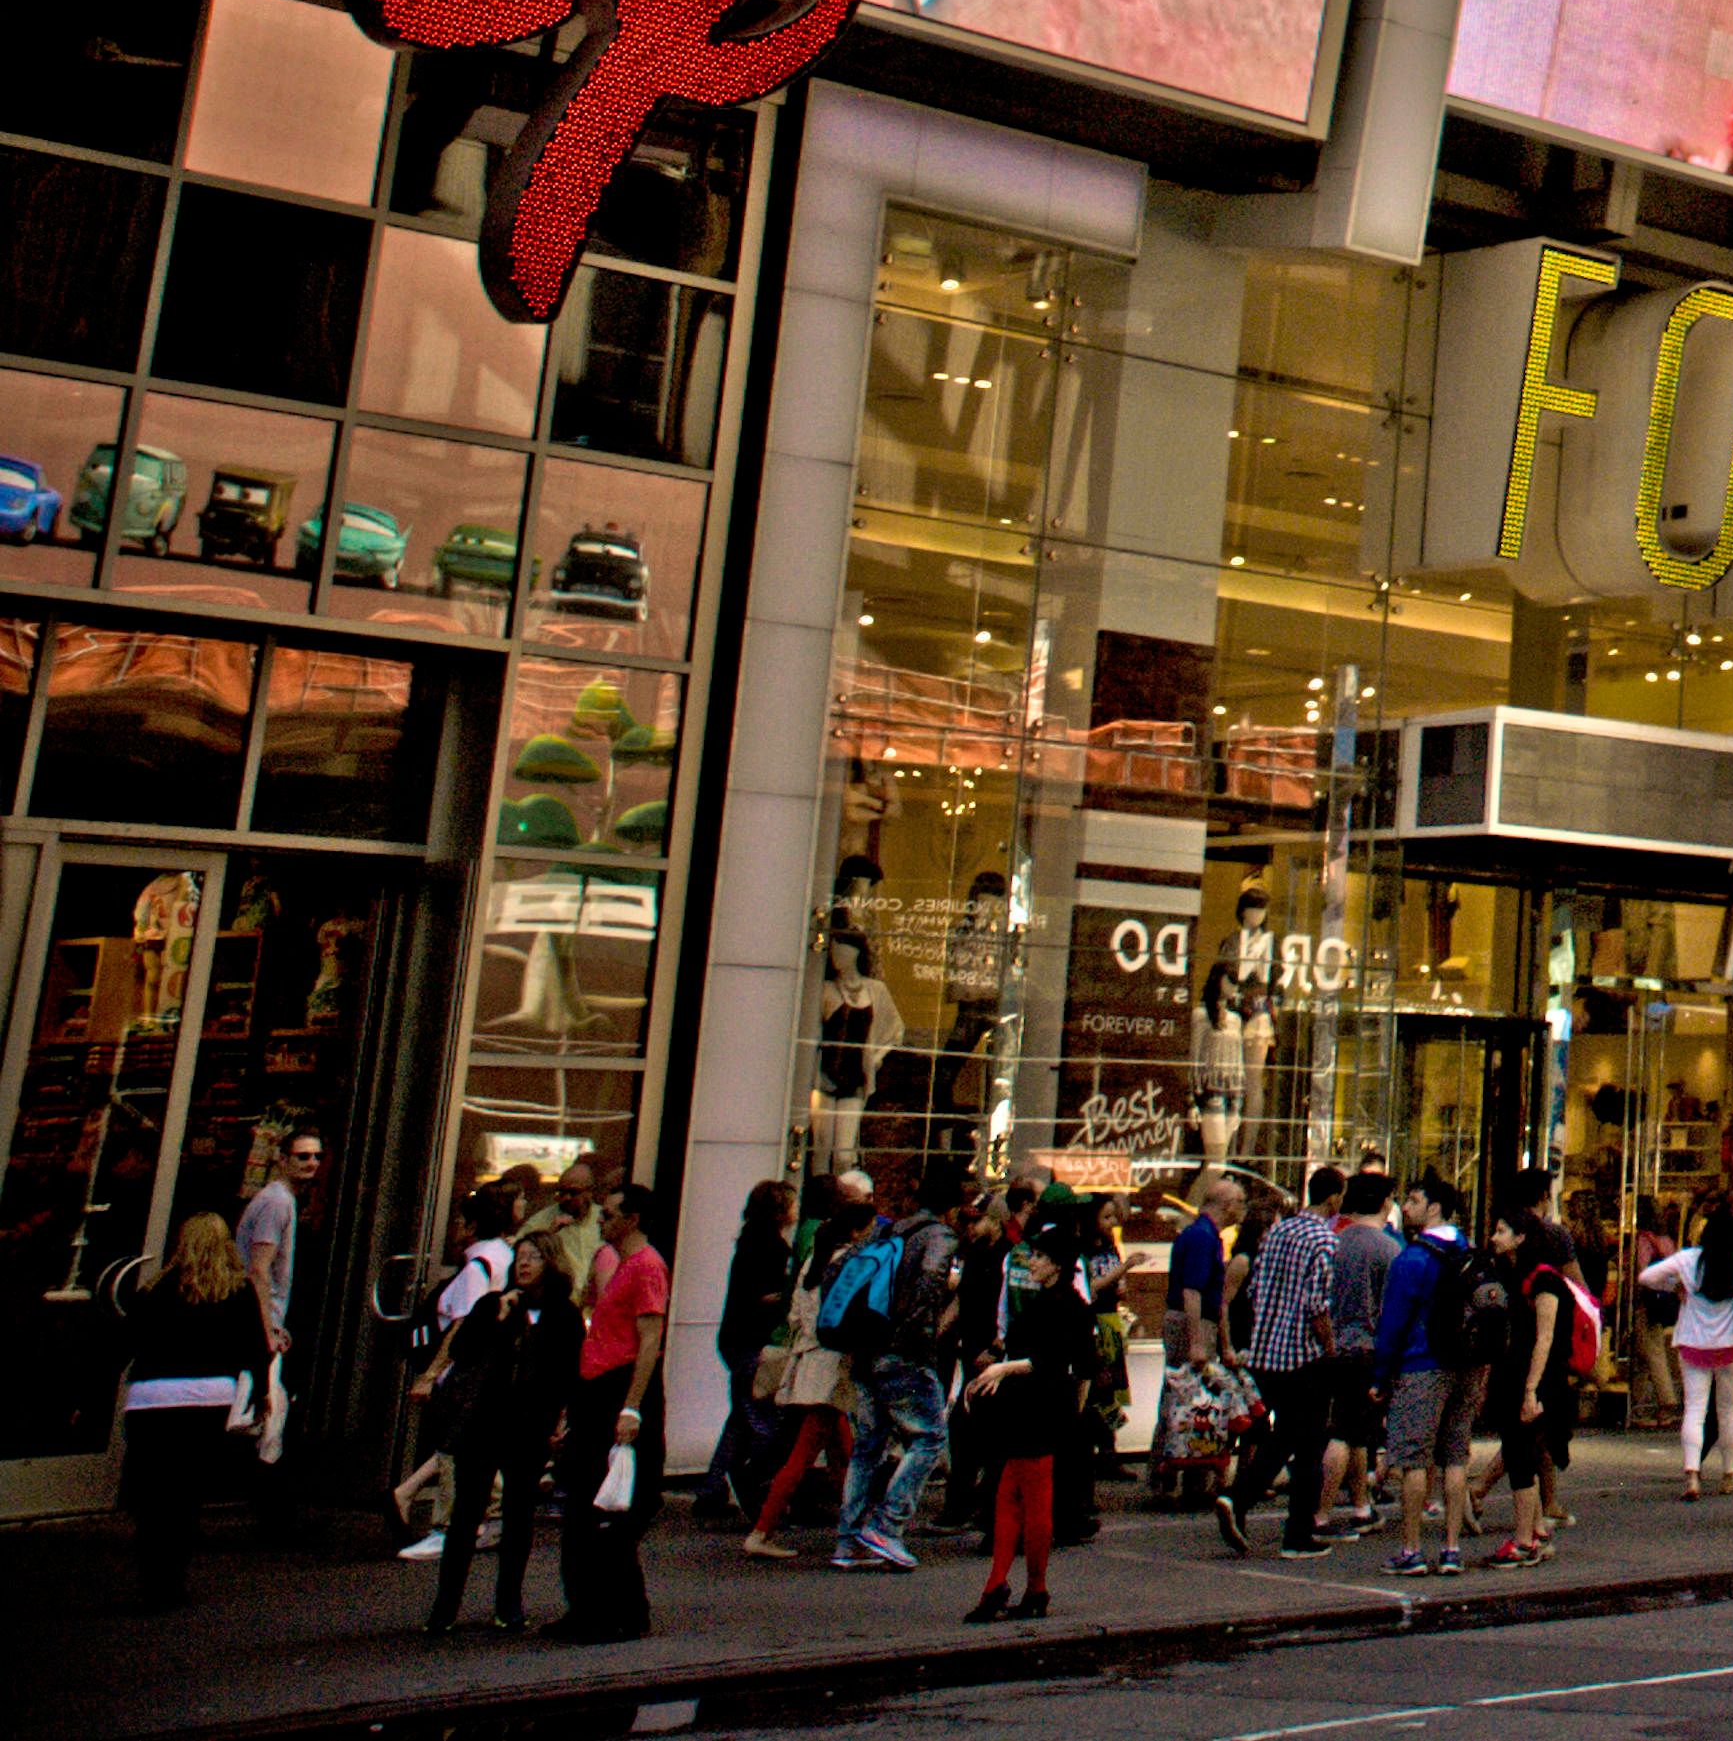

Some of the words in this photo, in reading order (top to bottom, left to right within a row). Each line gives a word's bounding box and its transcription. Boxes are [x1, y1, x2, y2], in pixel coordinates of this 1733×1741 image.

[1081, 1013, 1155, 1036] FOREVER
[1159, 1017, 1177, 1037] 21
[1076, 1079, 1164, 1144] Best
[1073, 1112, 1180, 1156] ummer
